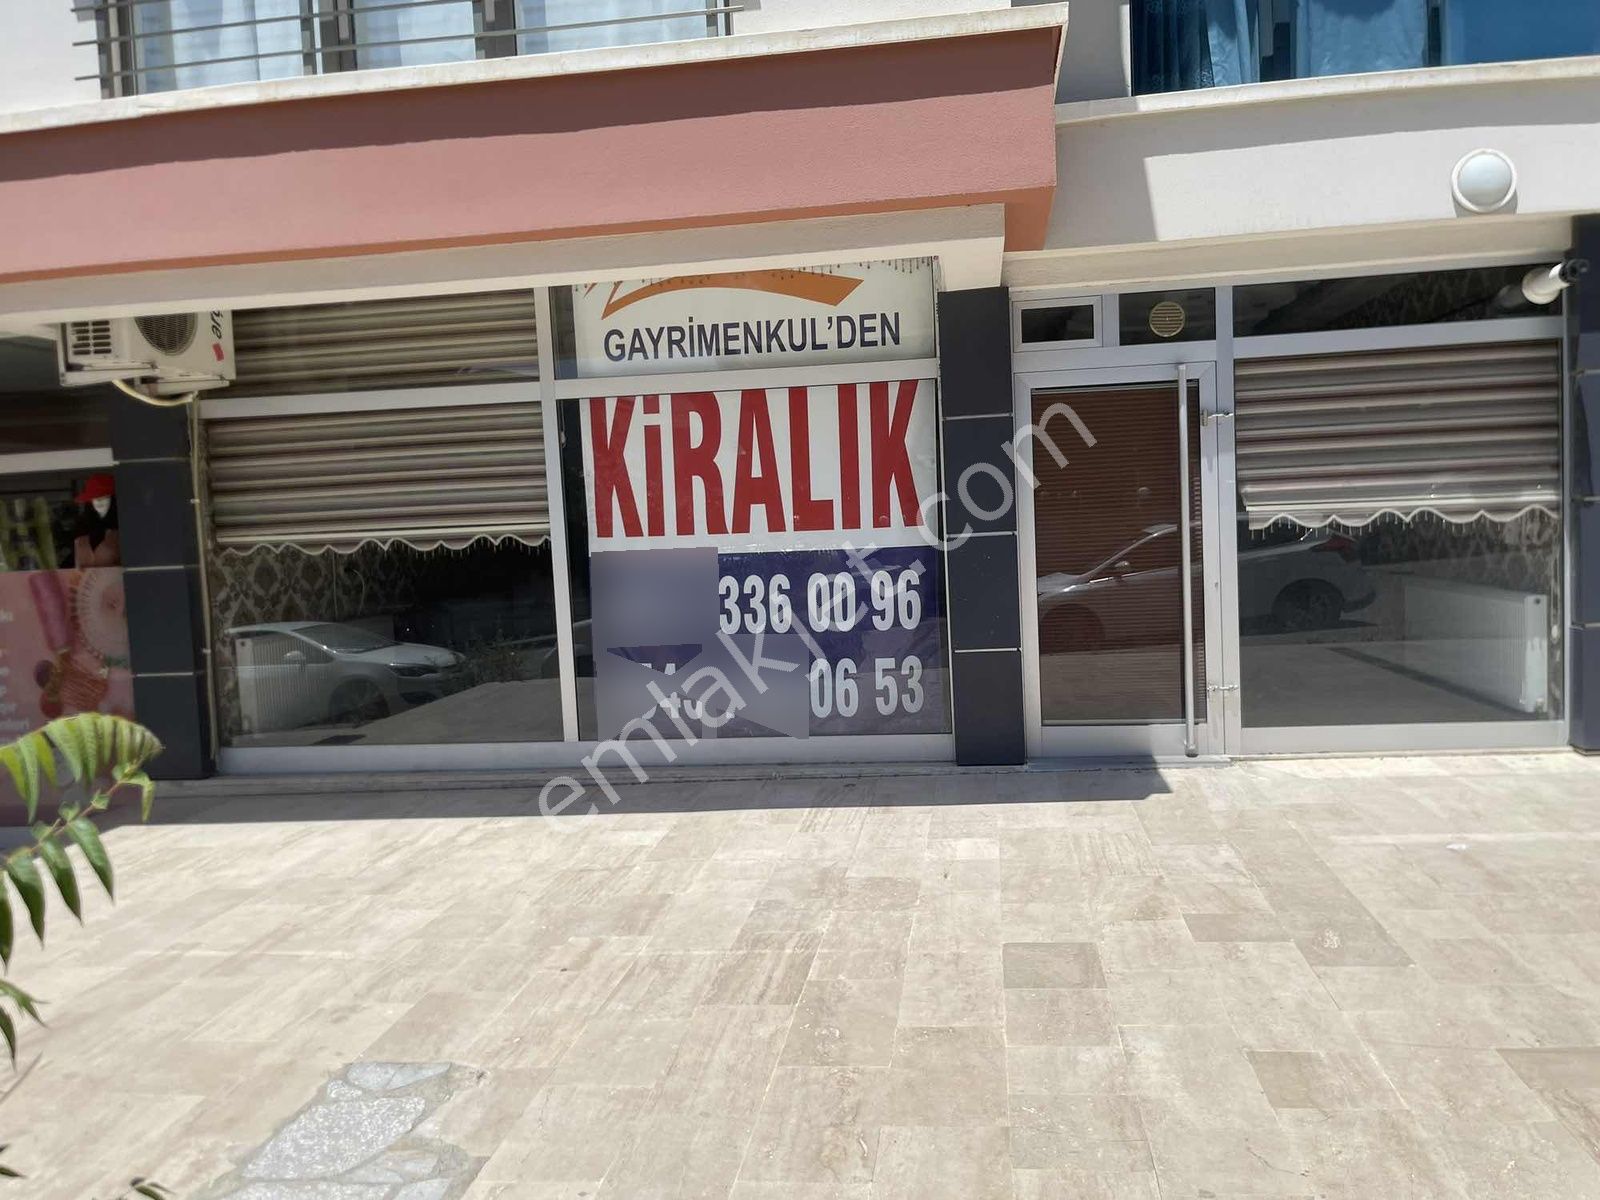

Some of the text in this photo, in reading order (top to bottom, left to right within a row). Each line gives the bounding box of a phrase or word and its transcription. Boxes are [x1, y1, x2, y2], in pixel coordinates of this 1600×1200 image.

[603, 311, 901, 362] GAYRİMENKUL'DEN
[718, 569, 922, 635] 336 00 96
[809, 657, 859, 719] 06
[874, 654, 925, 716] 53
